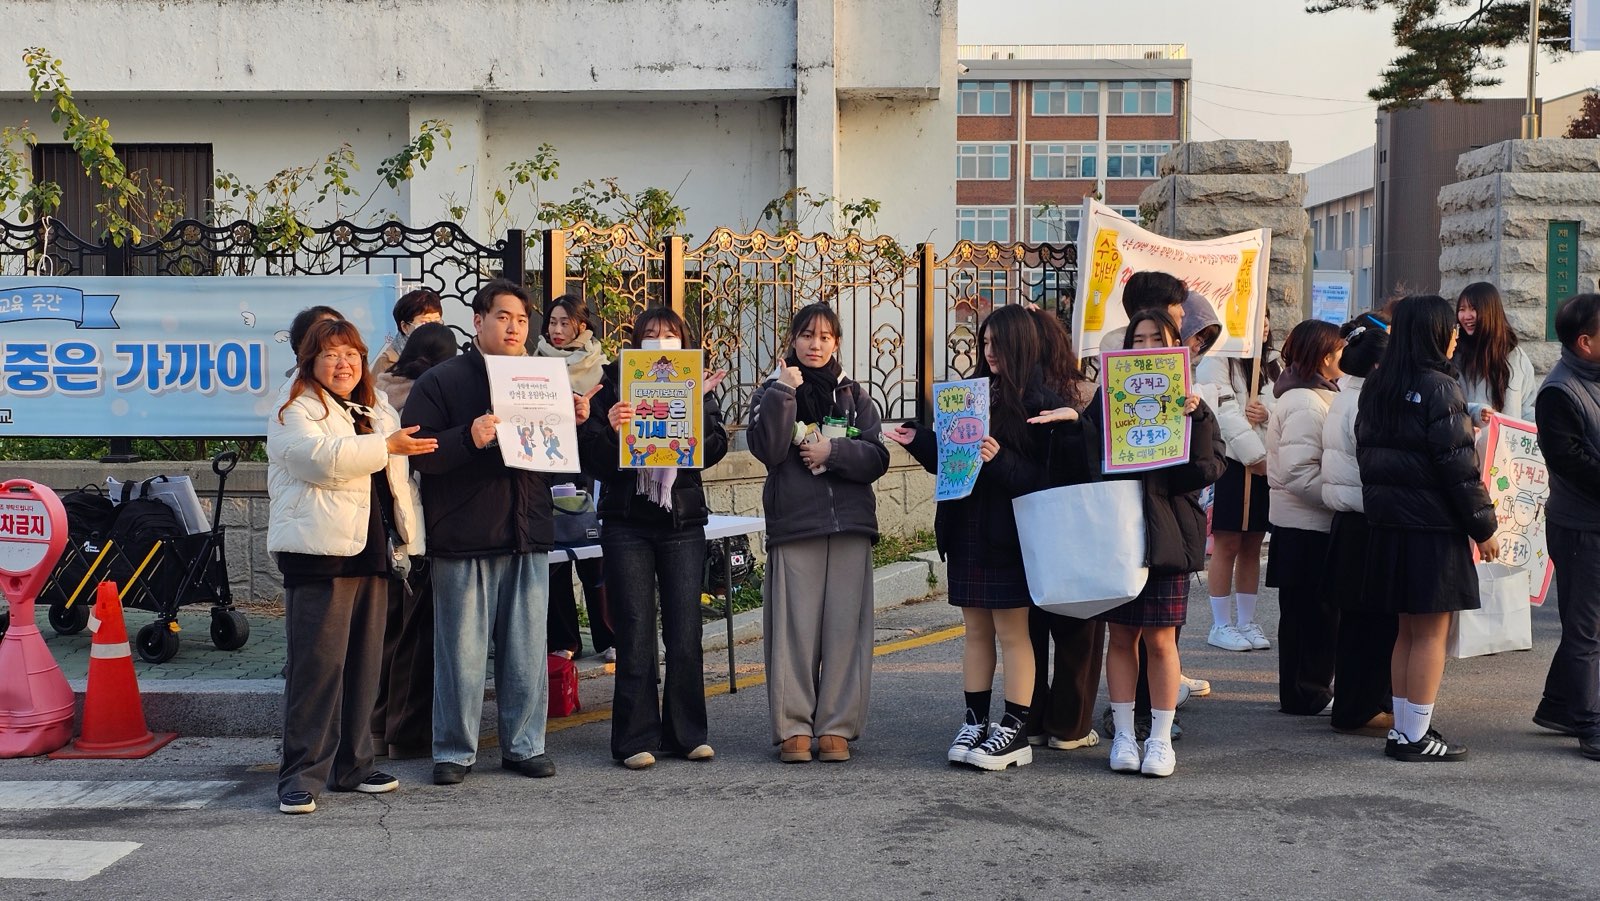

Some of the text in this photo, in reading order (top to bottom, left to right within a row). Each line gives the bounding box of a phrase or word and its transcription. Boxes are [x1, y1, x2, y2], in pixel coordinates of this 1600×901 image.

[32, 293, 62, 312] 주간
[0, 340, 265, 394] 중은 가까이
[1115, 359, 1132, 373] 수능
[1134, 358, 1153, 371] 행운
[635, 398, 687, 420] 수능은
[634, 420, 689, 439] 기세다!
[1115, 418, 1136, 429] LUCKY
[1118, 449, 1135, 462] 수능
[1158, 445, 1179, 457] 기원
[1520, 435, 1540, 456] 행운
[0, 513, 44, 536] 차금지
